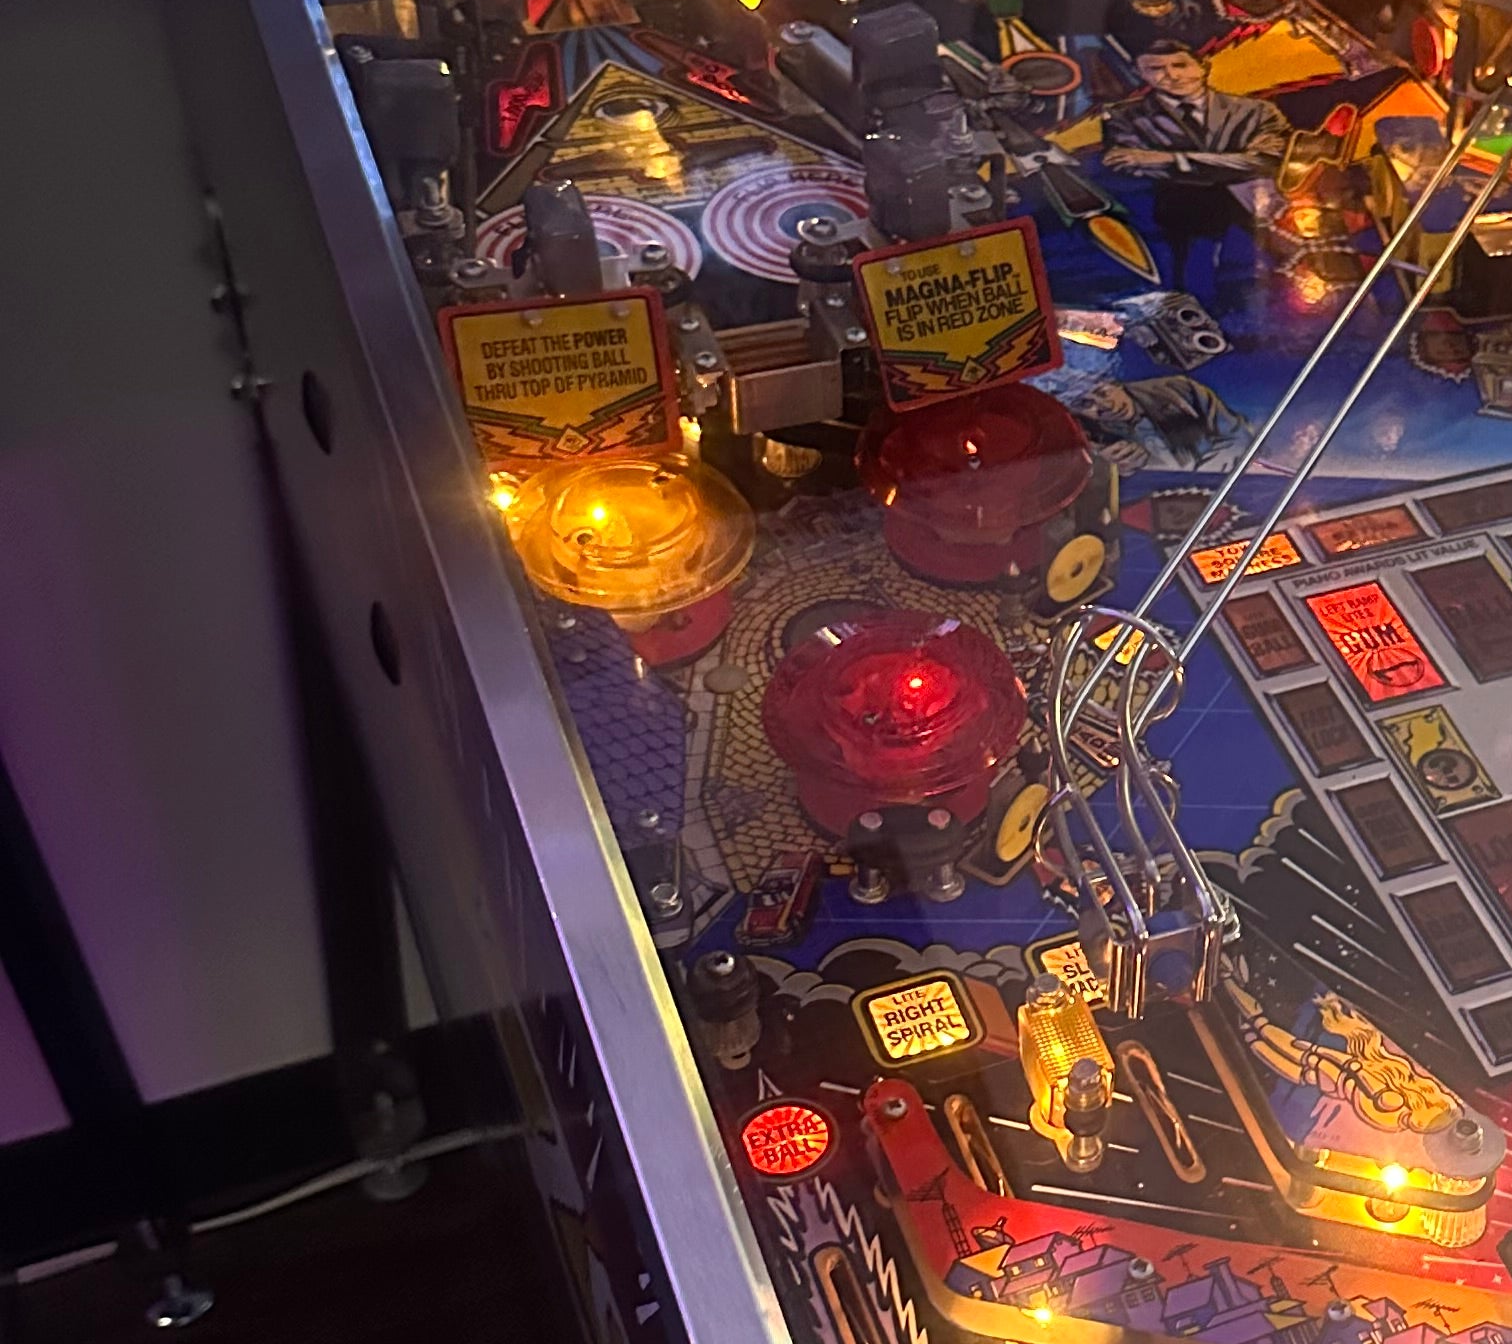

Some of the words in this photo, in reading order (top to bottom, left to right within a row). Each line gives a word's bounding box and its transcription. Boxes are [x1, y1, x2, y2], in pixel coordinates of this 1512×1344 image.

[901, 269, 917, 282] TO
[918, 264, 942, 278] USE
[885, 304, 924, 327] FLIP
[926, 291, 980, 316] WHEN
[982, 280, 1028, 303] BALL
[897, 324, 916, 342] IS
[917, 319, 936, 337] IN
[936, 309, 974, 333] RED
[976, 297, 1025, 323] ZONE
[480, 336, 539, 359] DEFEAT
[541, 334, 573, 353] THE
[573, 327, 628, 349] POWER
[486, 362, 507, 380] BY
[508, 354, 589, 378] SHOOTING
[591, 348, 631, 371] BALL
[473, 382, 518, 402] THRU
[519, 378, 551, 398] TOP
[553, 374, 576, 394] OF
[577, 367, 649, 392] PYRAMID
[1340, 621, 1406, 656] GUM
[884, 996, 946, 1028] RIGHT
[892, 989, 926, 1007] LITE
[886, 1013, 962, 1048] SPIRAL
[747, 1115, 819, 1151] EXTRA
[762, 1138, 816, 1165] BALL
